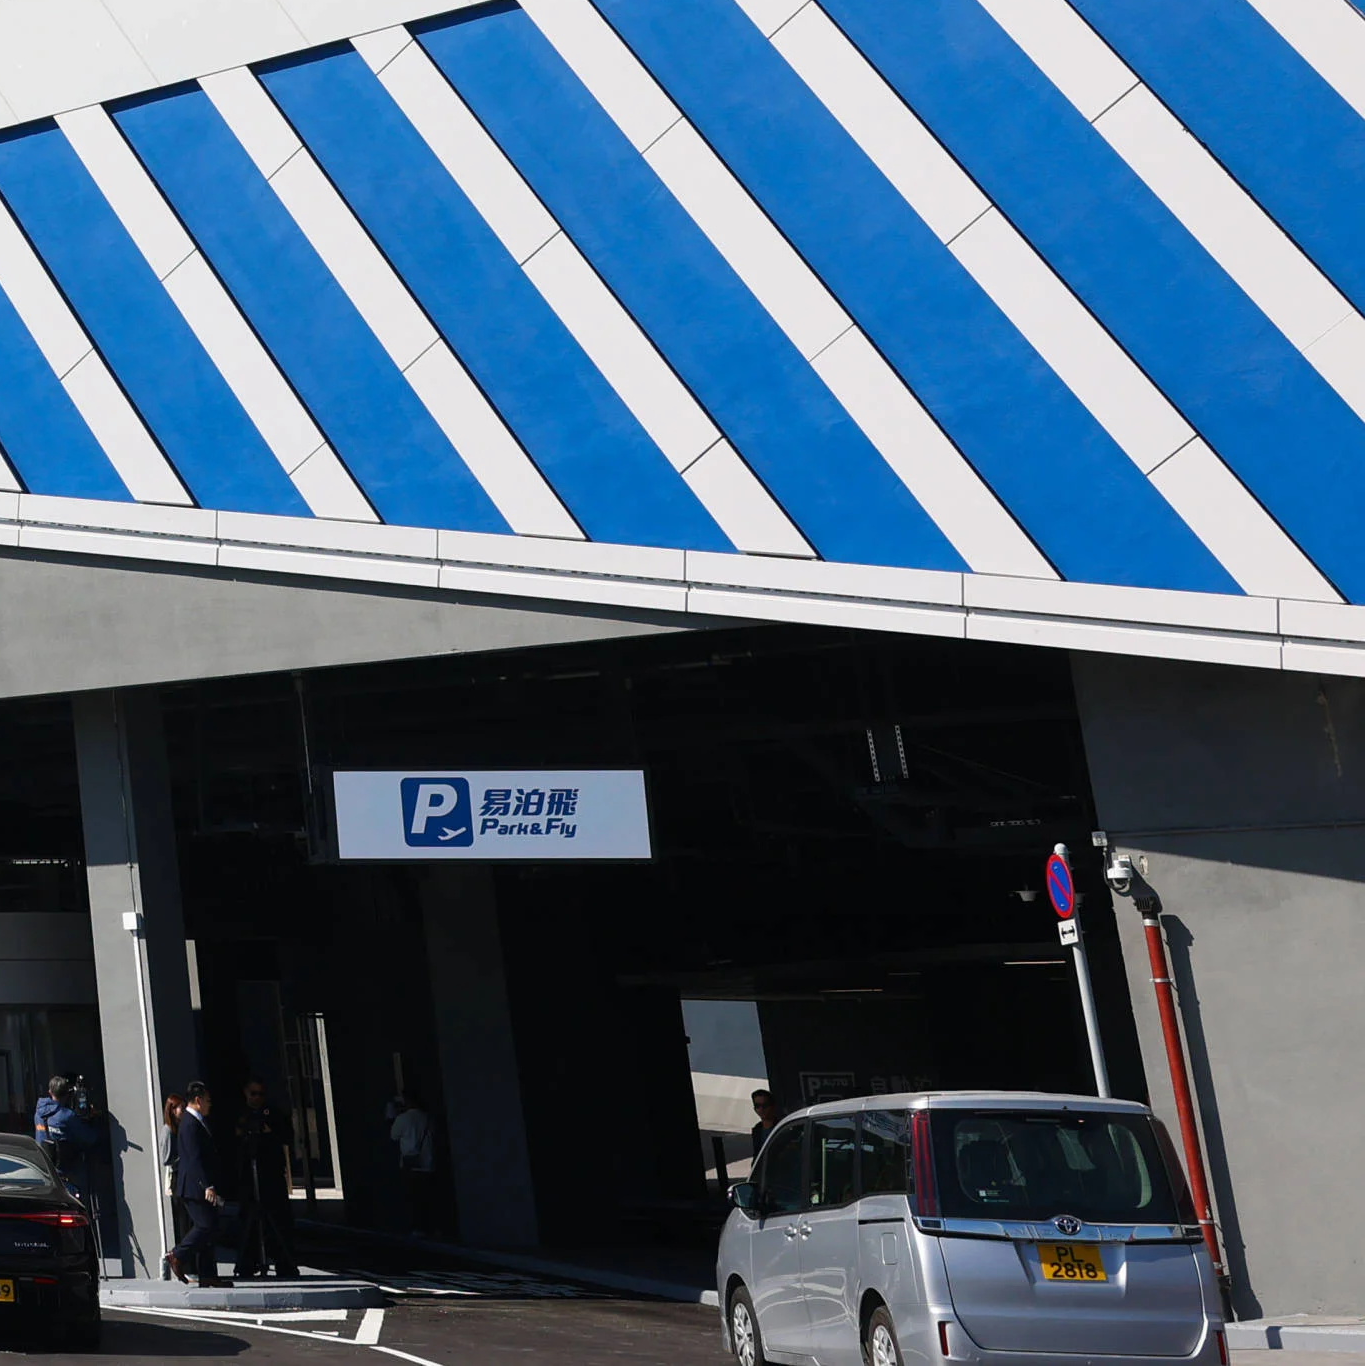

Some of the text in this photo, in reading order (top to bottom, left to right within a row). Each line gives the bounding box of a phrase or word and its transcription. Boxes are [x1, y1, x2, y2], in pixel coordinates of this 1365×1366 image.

[410, 783, 458, 834] P
[478, 788, 580, 816] 易泊飛
[478, 817, 577, 838] Park&Fly
[1055, 1246, 1084, 1263] PL
[1049, 1262, 1098, 1279] 2818
